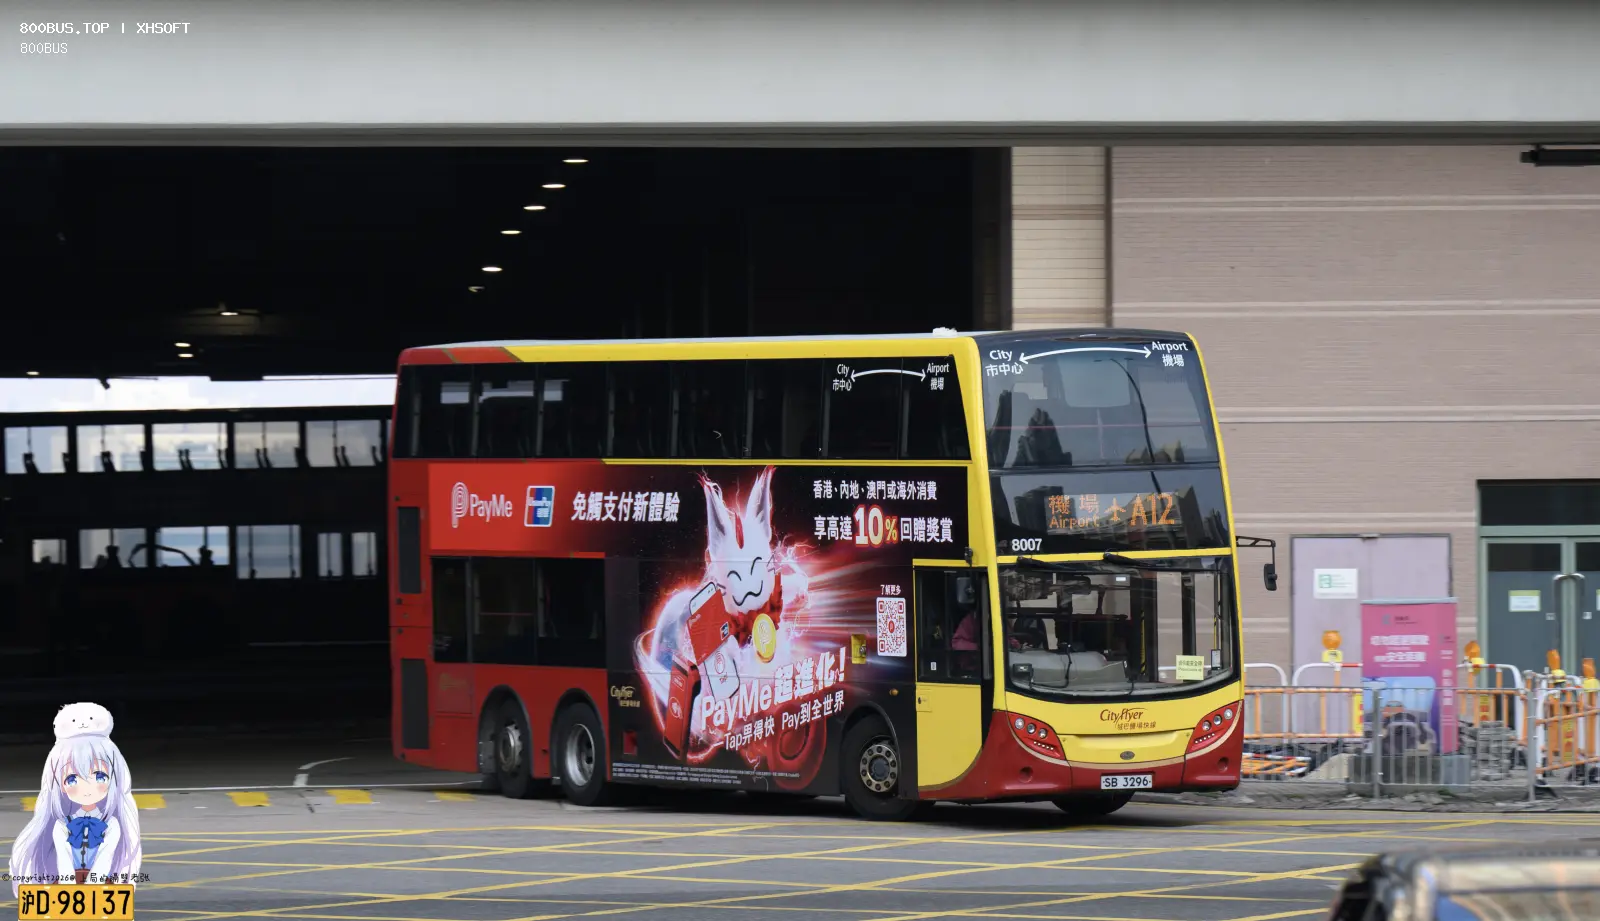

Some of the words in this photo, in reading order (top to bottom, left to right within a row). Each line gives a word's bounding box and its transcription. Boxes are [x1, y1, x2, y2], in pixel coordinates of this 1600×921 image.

[1151, 341, 1189, 353] Airport
[989, 349, 1013, 362] City
[1162, 354, 1185, 367] 機場
[836, 363, 850, 377] City
[926, 362, 950, 376] Airport
[985, 361, 1024, 377] 市中心
[832, 378, 852, 391] 市中心
[930, 377, 945, 391] 機場
[469, 493, 513, 523] PayMe
[571, 491, 681, 522] 免觸支付新體驗
[1048, 494, 1099, 515] 機場
[1130, 493, 1176, 527] A12
[1049, 515, 1100, 530] Airport
[1011, 538, 1043, 551] 8007
[880, 584, 902, 596] 了解更多
[1104, 777, 1118, 788] SB
[1122, 776, 1149, 788] 3296
